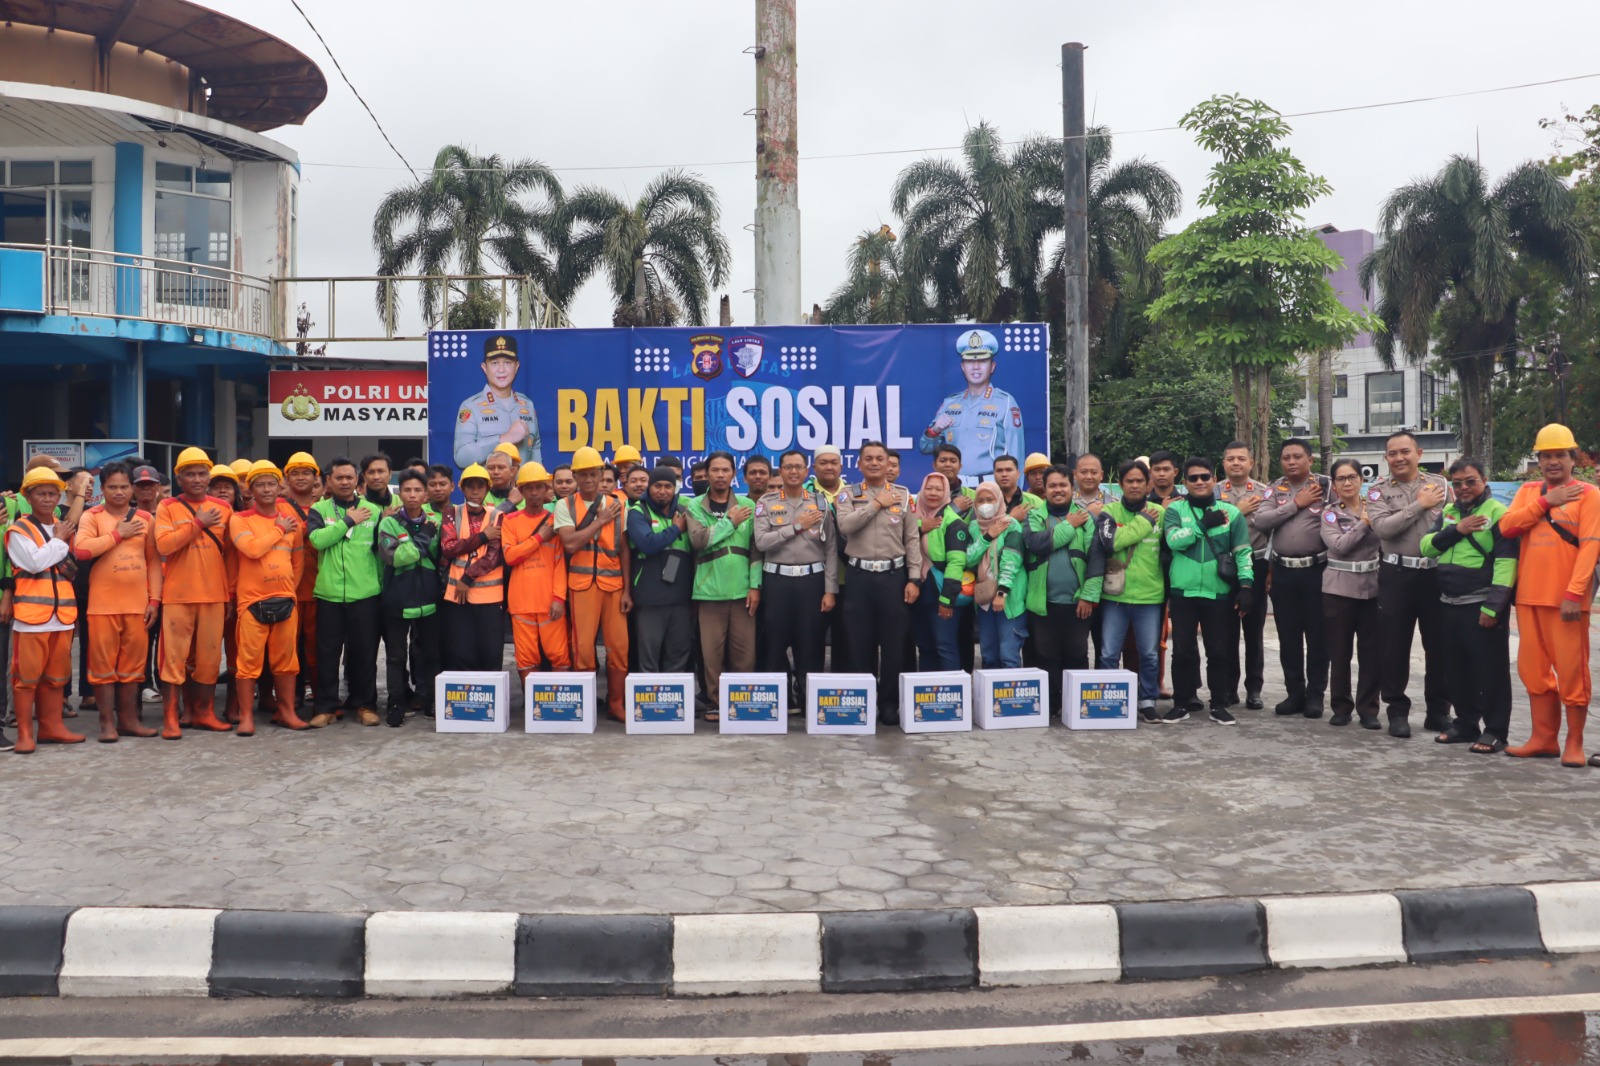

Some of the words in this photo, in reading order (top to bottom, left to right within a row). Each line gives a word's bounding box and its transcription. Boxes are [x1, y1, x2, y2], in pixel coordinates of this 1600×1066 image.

[323, 385, 390, 400] POLRI
[557, 387, 705, 452] BAKTI
[725, 385, 913, 451] SOSIAL
[446, 691, 467, 701] BAKTI
[469, 691, 493, 702] SOSIAL
[534, 691, 555, 702] BAKTI
[557, 692, 582, 702] SOSIAL
[635, 692, 656, 703] BAKTI
[658, 692, 683, 702] SOSIAL
[729, 692, 751, 702] BAKTI
[752, 691, 778, 702] SOSIAL
[915, 693, 936, 703] BAKTI
[937, 692, 962, 702] SOSIAL
[994, 688, 1014, 698] BAKTI
[1015, 687, 1039, 697] SOSIAL
[1082, 689, 1102, 700] BAKTI
[1103, 689, 1128, 700] SOSIAL
[819, 696, 840, 706] BAKTI
[841, 696, 867, 706] SOSIAL
